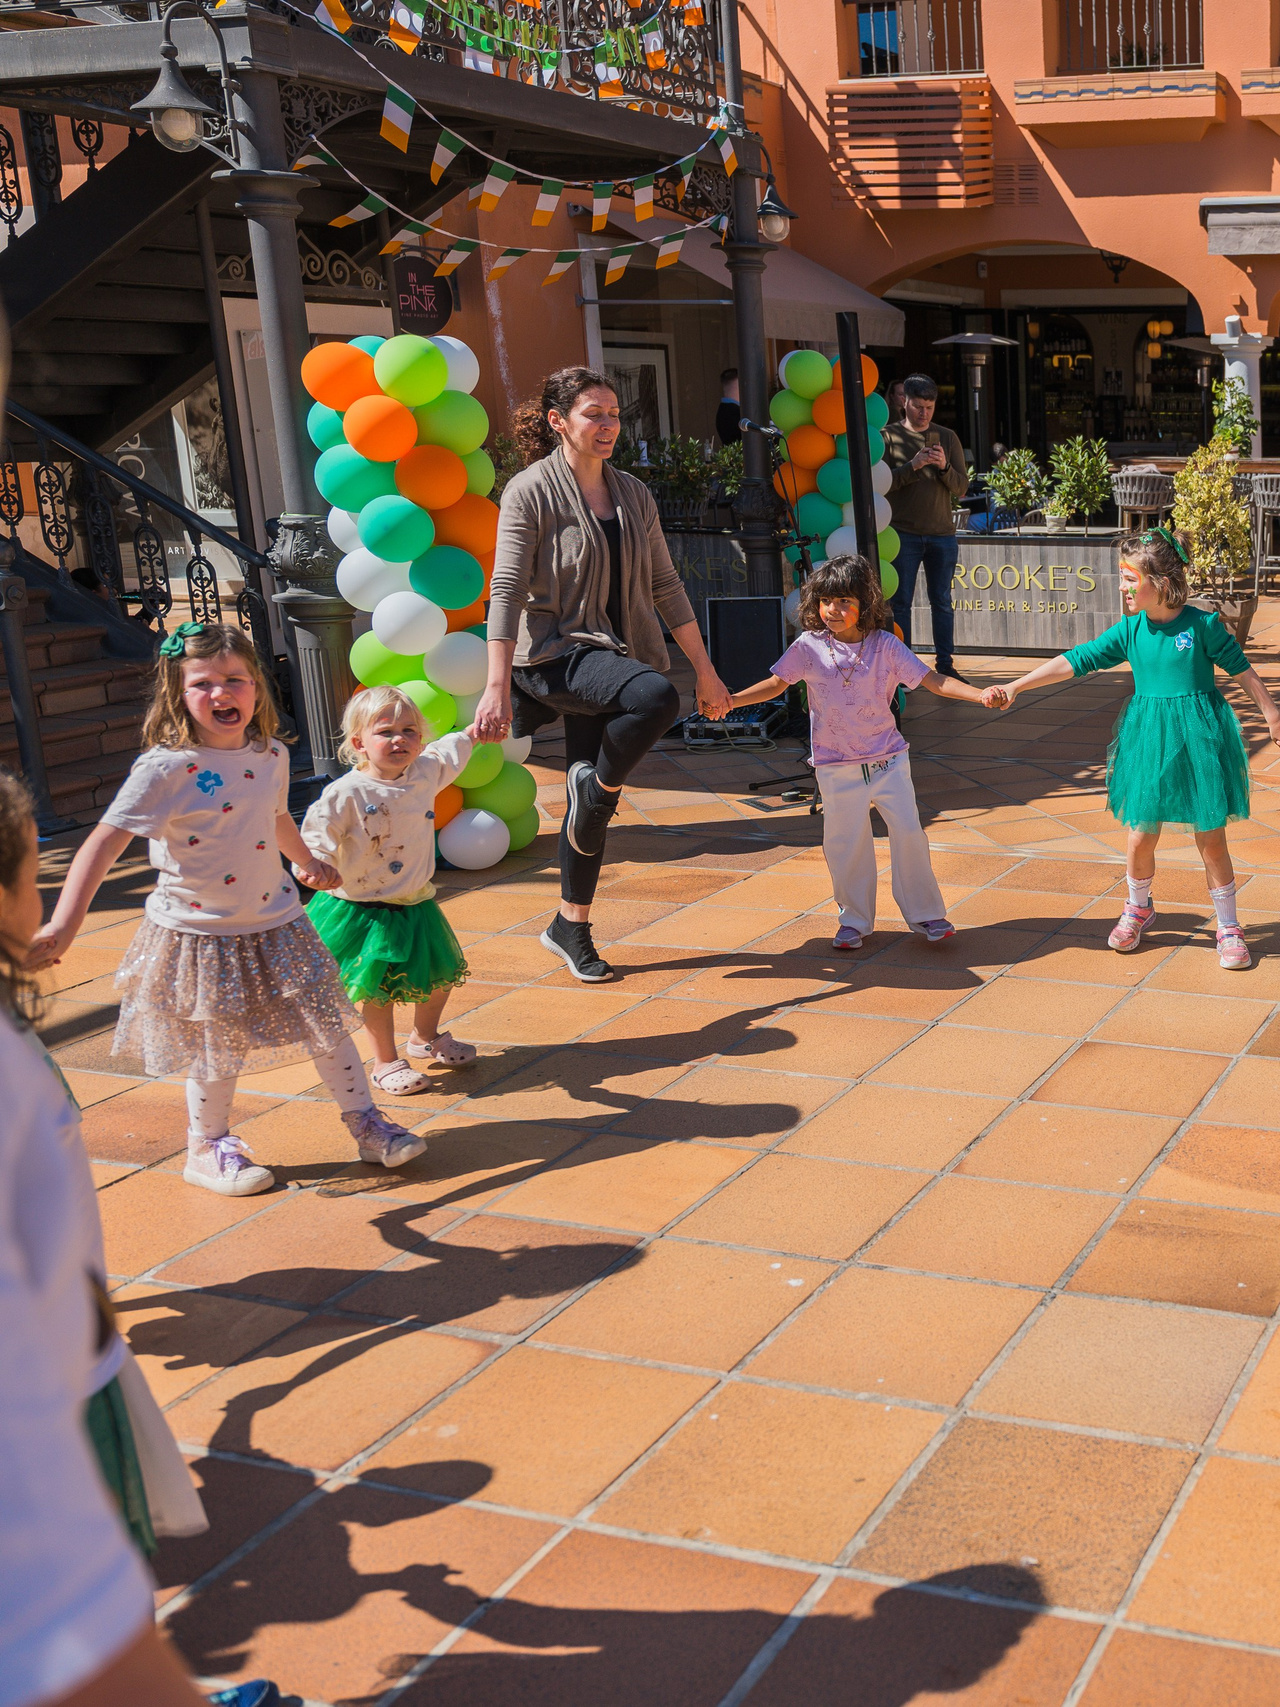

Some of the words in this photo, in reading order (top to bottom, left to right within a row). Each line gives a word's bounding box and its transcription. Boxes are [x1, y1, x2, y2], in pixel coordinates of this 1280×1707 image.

[408, 272, 417, 282] IN
[409, 284, 436, 296] THE
[399, 294, 438, 312] PINK
[167, 546, 185, 555] ART
[951, 563, 1098, 592] ROOKE'S
[988, 600, 1016, 612] BAR
[1021, 600, 1032, 612] &
[1037, 601, 1079, 613] SHOP
